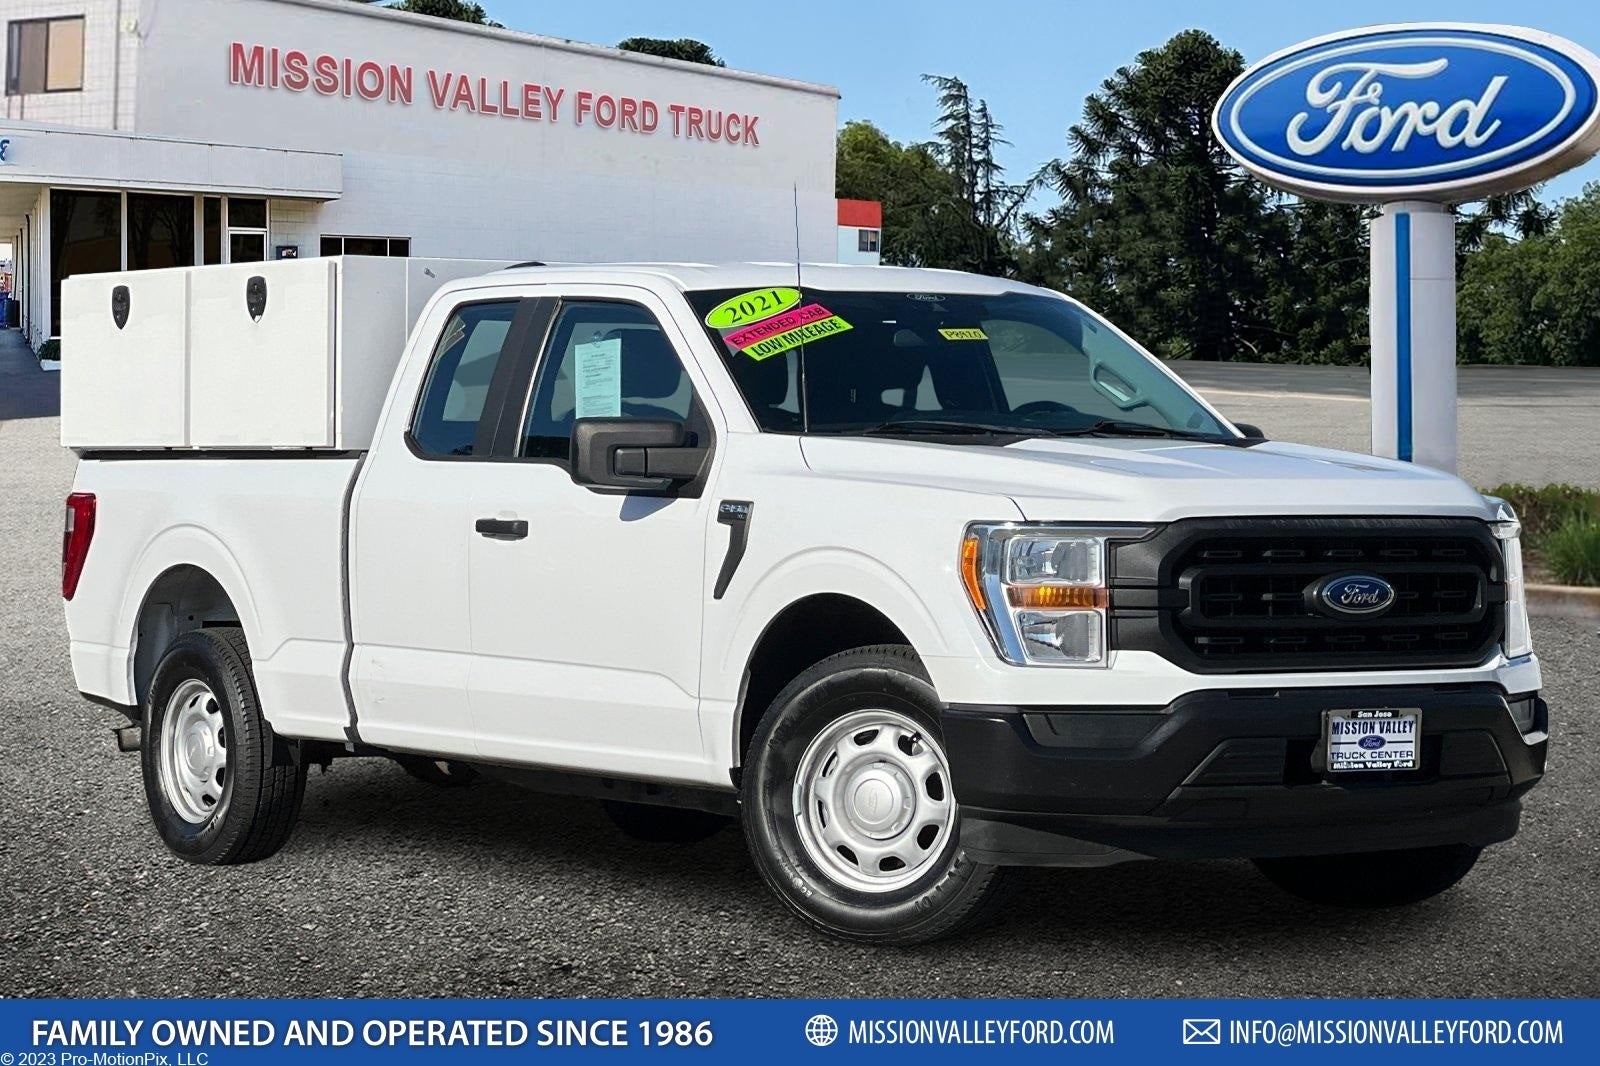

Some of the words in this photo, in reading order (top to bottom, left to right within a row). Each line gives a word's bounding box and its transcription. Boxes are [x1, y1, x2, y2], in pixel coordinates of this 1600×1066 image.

[229, 41, 413, 104] MISSION
[428, 69, 565, 121] VALLEY
[575, 90, 660, 133] FORD
[669, 103, 761, 145] TRUCK
[1286, 57, 1509, 156] Ford
[724, 290, 783, 324] 2021
[731, 316, 796, 346] EXTENDED
[751, 339, 784, 357] LOW
[781, 318, 842, 345] MILEAGE
[1341, 583, 1380, 604] Ford
[1374, 710, 1393, 718] Jose
[1332, 721, 1376, 735] MISSION
[1379, 720, 1414, 734] VALLEY
[1331, 751, 1367, 760] TRUCK
[1370, 751, 1413, 759] CENTER
[1366, 761, 1392, 769] Valley
